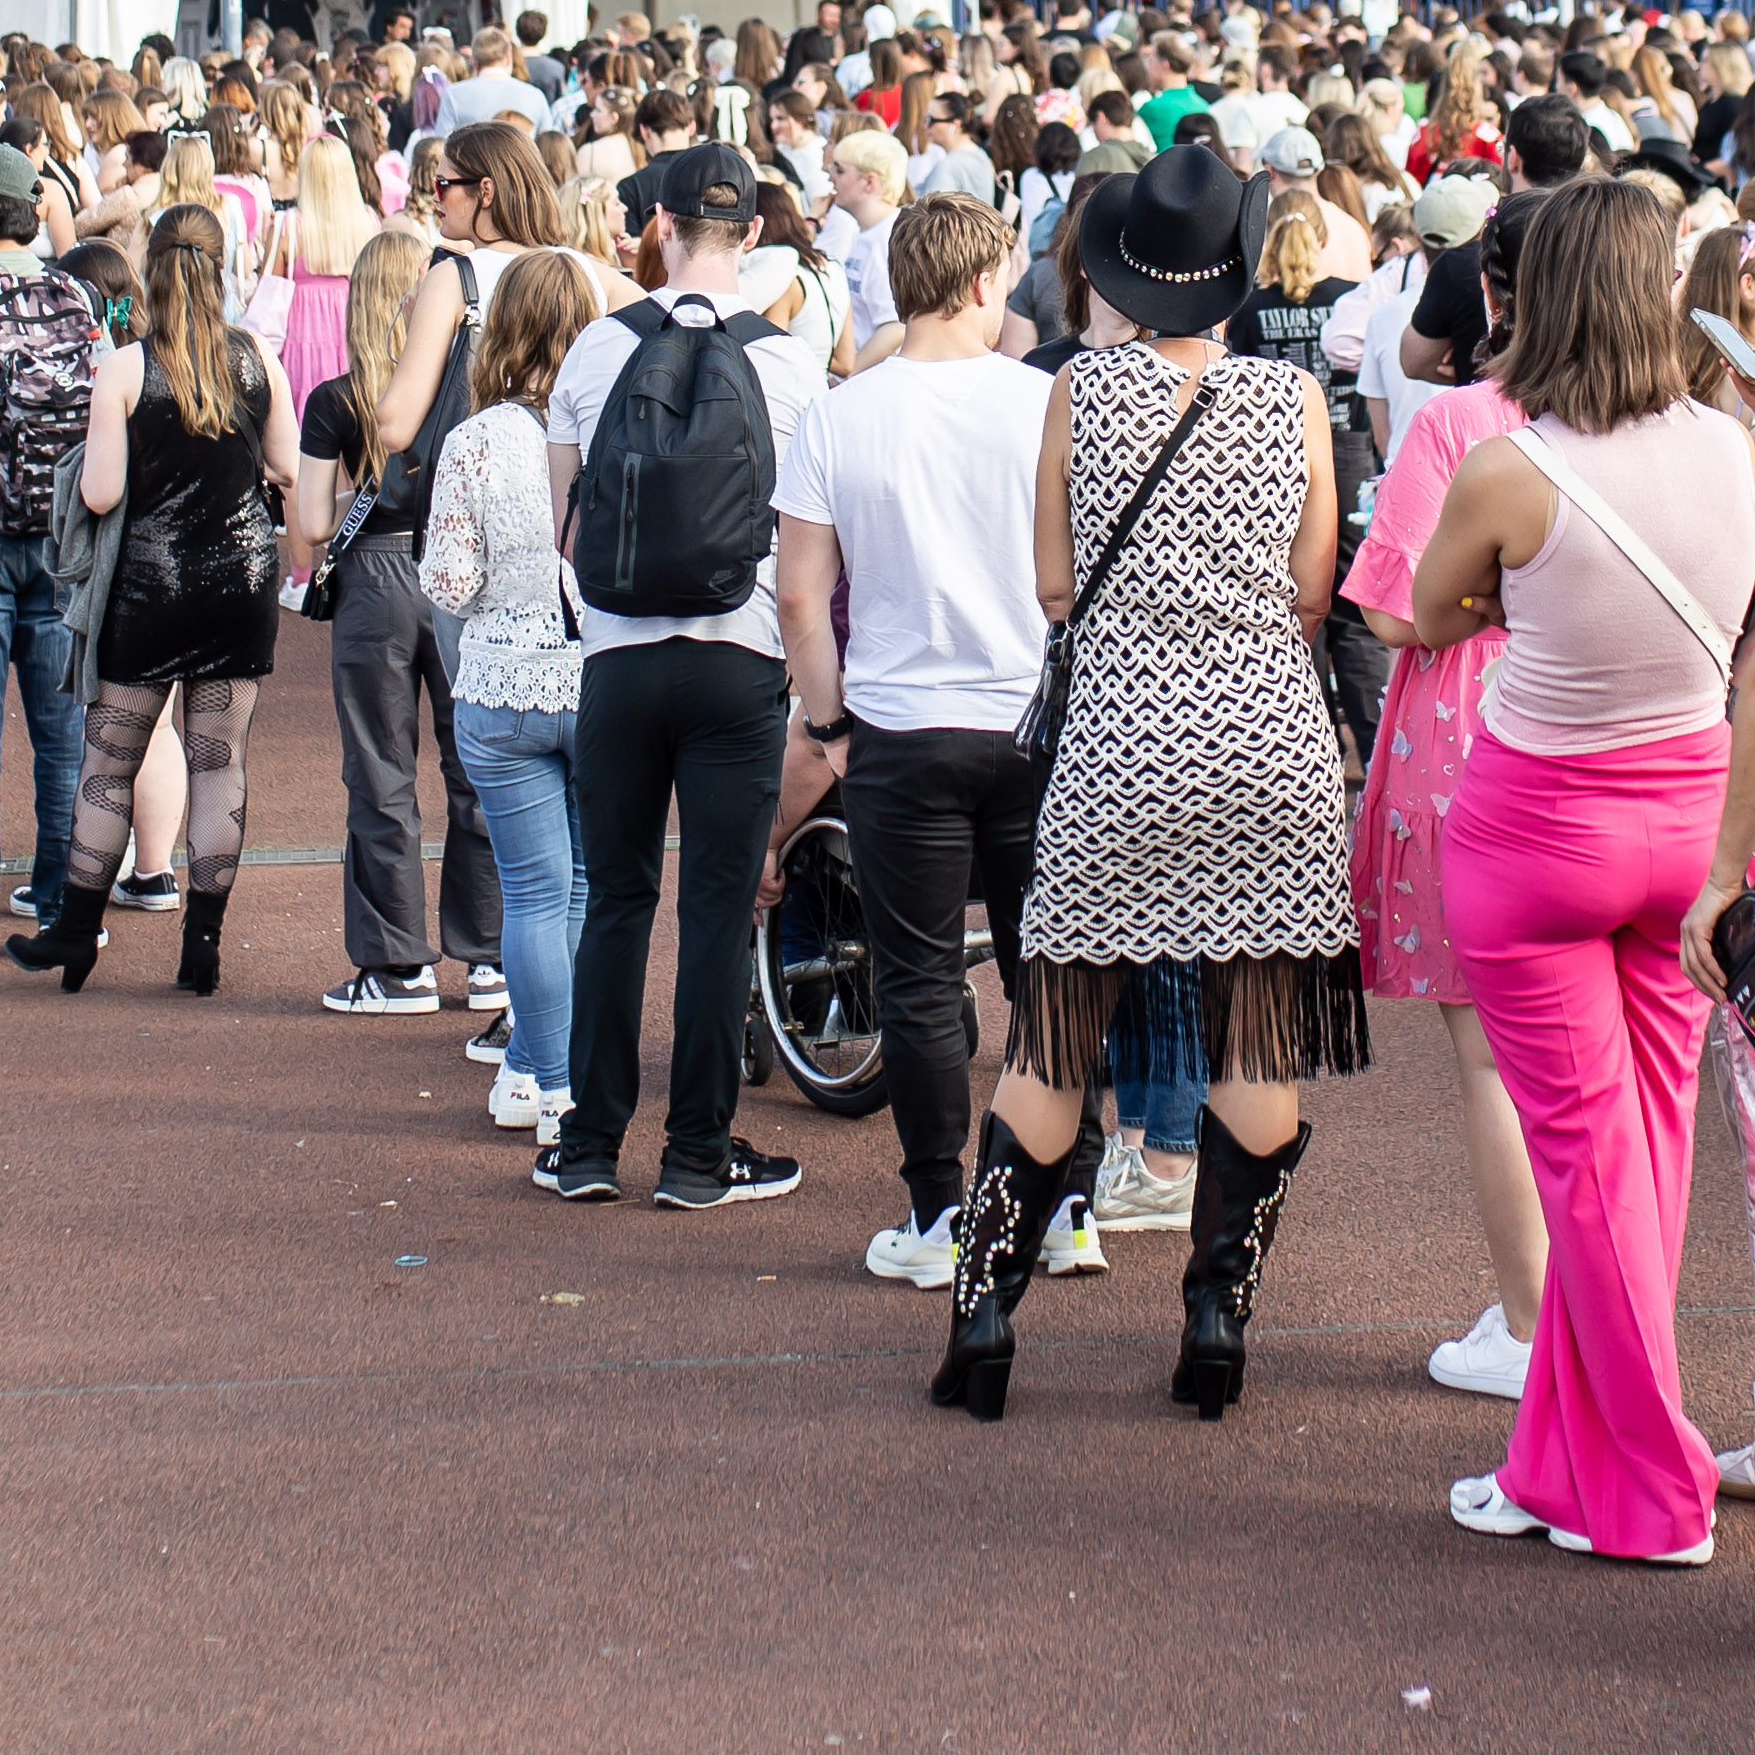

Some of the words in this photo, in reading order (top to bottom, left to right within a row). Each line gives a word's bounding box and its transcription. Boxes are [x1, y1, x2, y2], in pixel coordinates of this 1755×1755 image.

[1256, 307, 1309, 328] TAYLOR
[1262, 327, 1285, 341] THE
[1286, 326, 1320, 339] ERAS
[342, 493, 373, 537] GUESS
[510, 1091, 530, 1101] FILA
[541, 1109, 559, 1118] FILA
